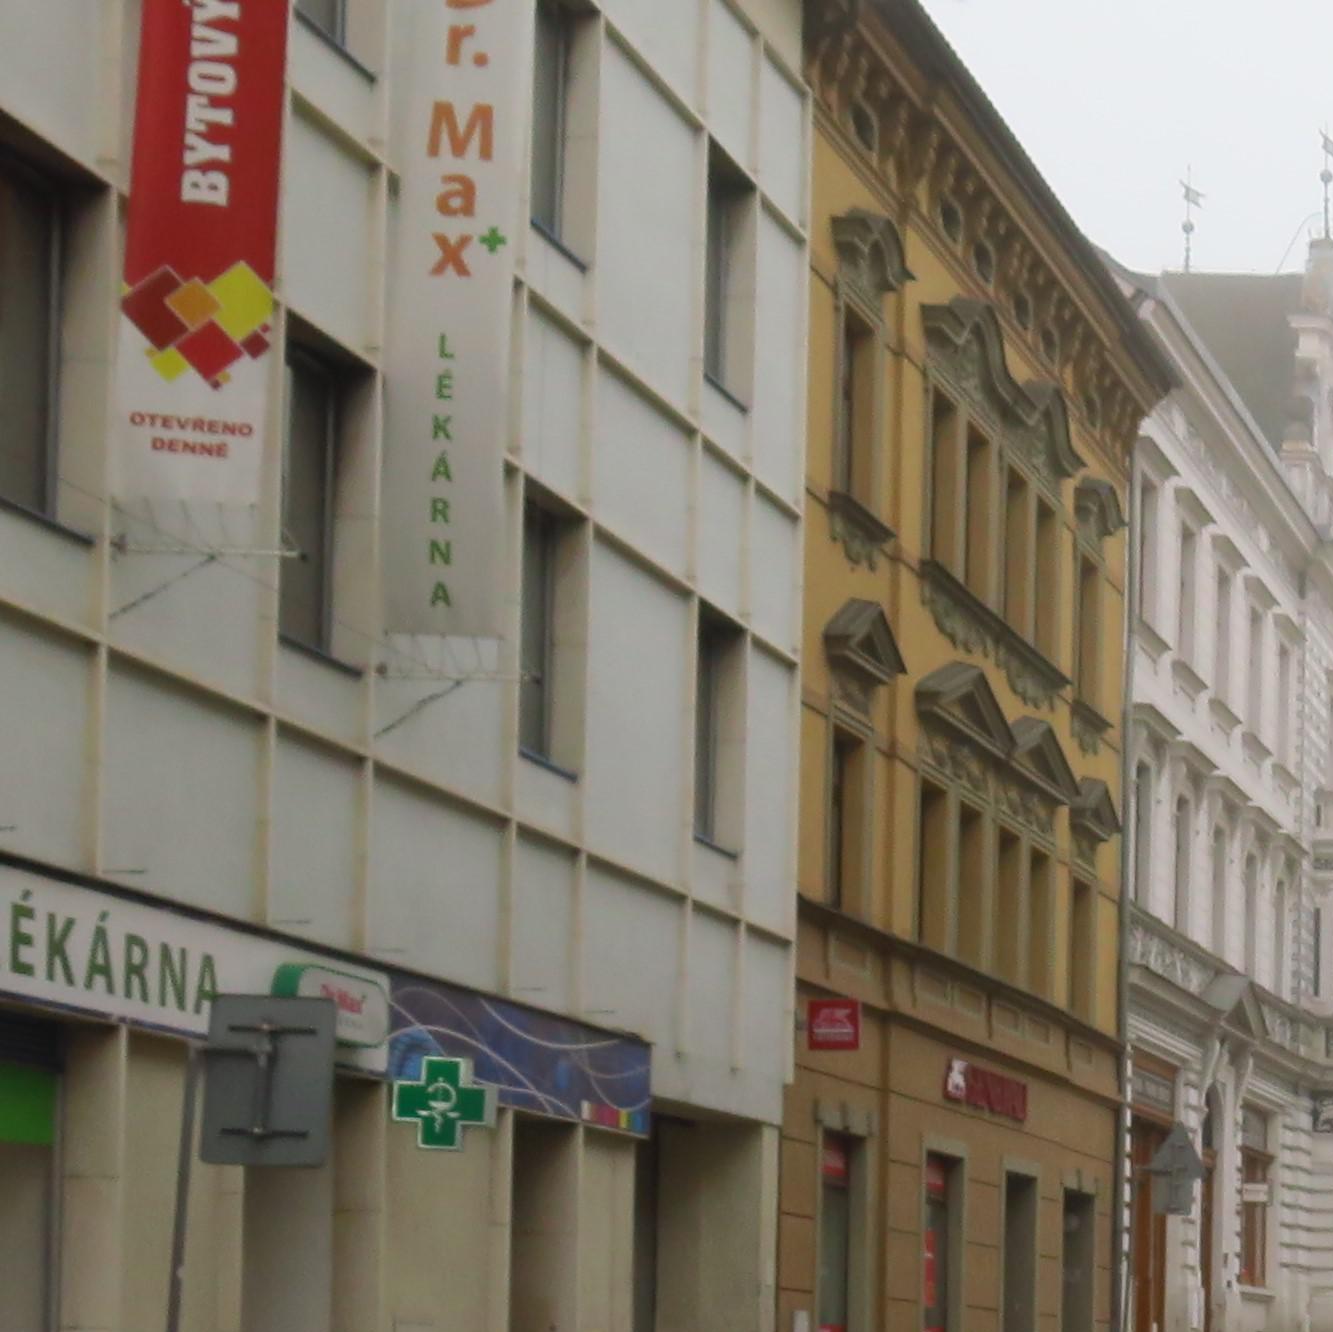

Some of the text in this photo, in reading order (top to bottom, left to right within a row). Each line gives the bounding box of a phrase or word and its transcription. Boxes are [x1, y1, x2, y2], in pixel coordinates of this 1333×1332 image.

[427, 101, 494, 277] Max
[429, 333, 454, 608] LÉKÁRNA
[1, 888, 218, 1015] ÉKÁRNA
